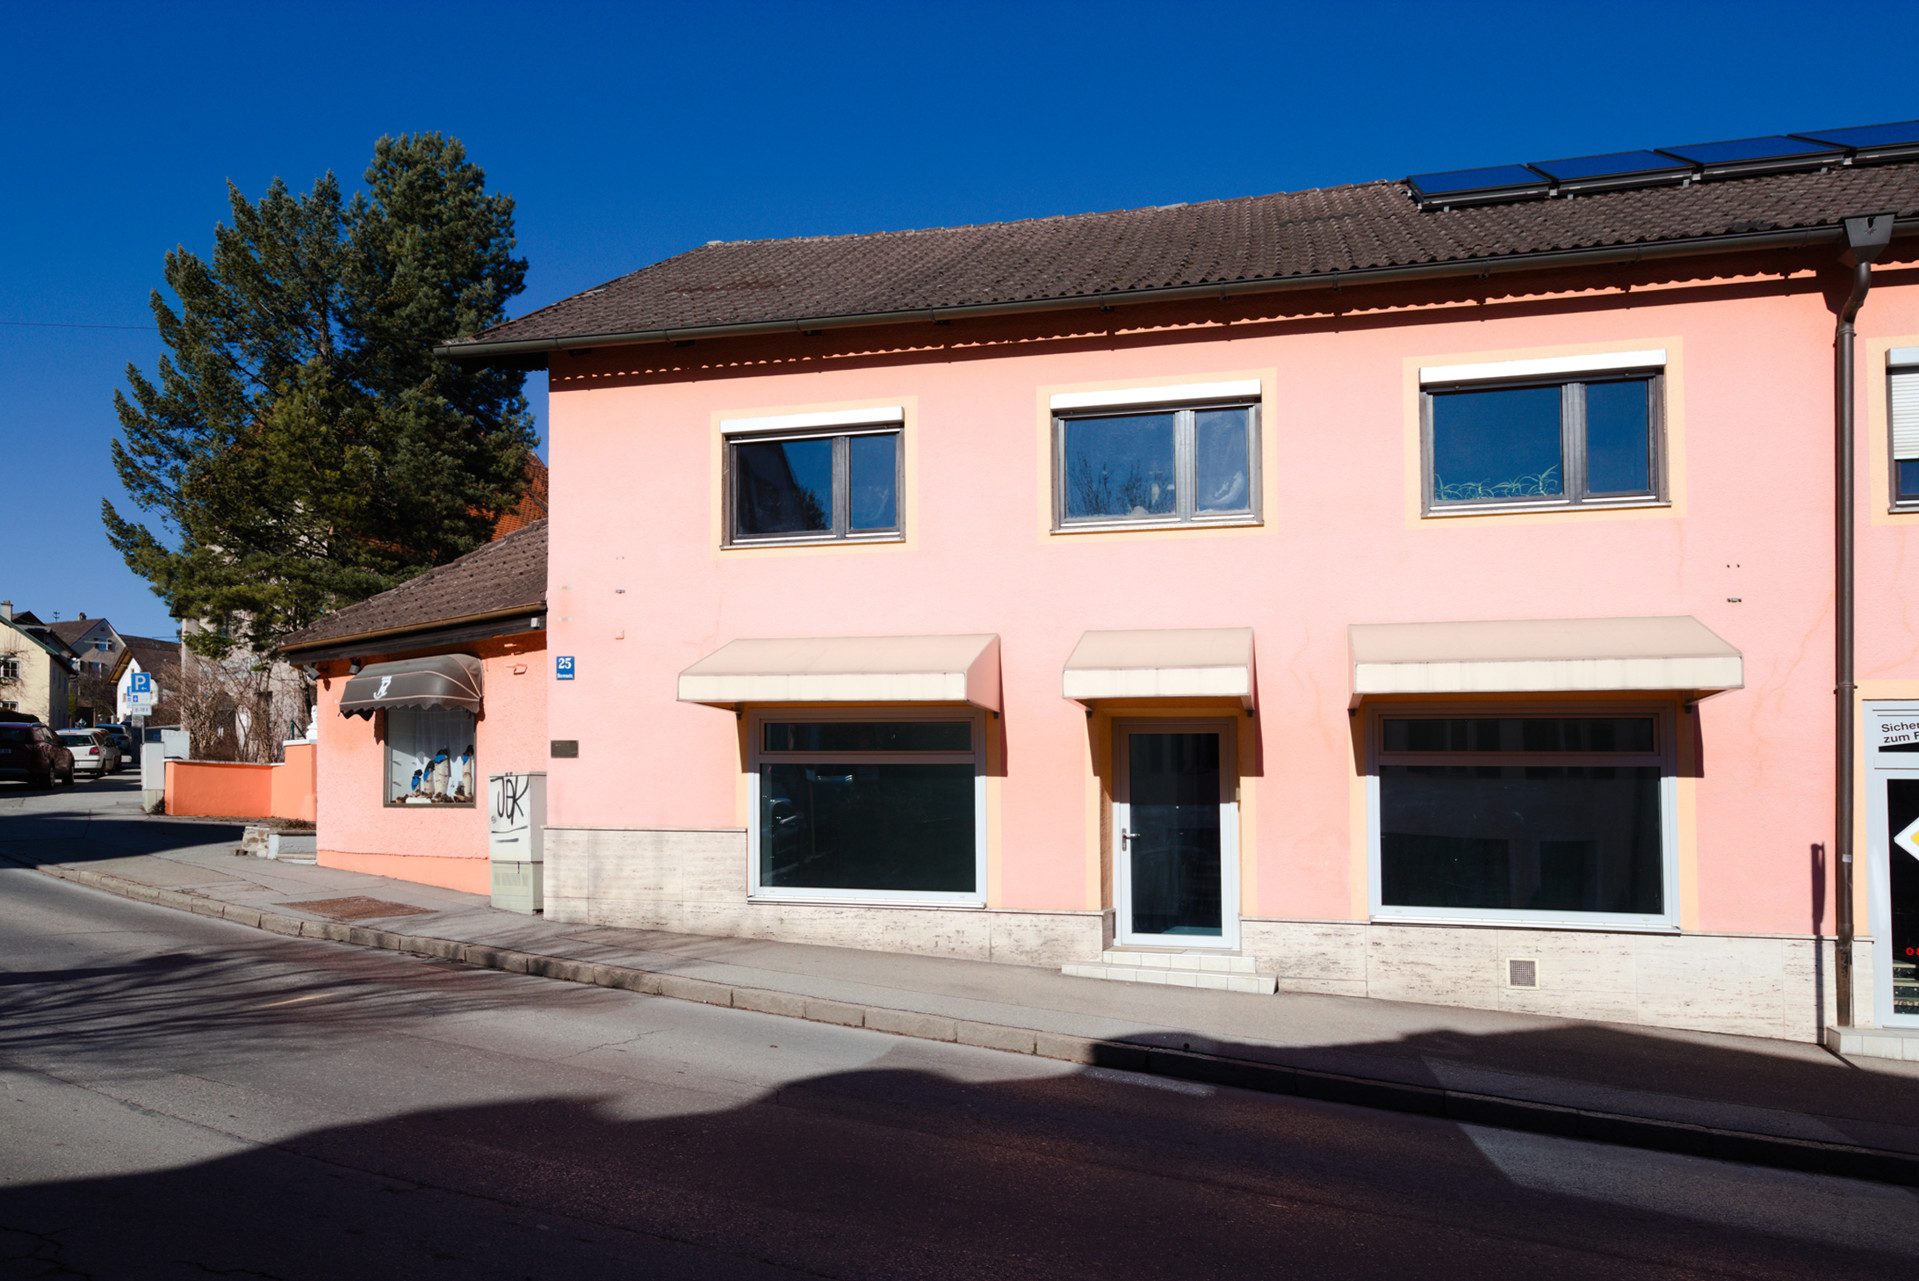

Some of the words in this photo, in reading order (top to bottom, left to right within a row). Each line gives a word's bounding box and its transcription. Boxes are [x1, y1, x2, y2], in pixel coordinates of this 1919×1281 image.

[558, 657, 572, 669] 25
[135, 675, 146, 690] P
[1884, 734, 1910, 743] zum
